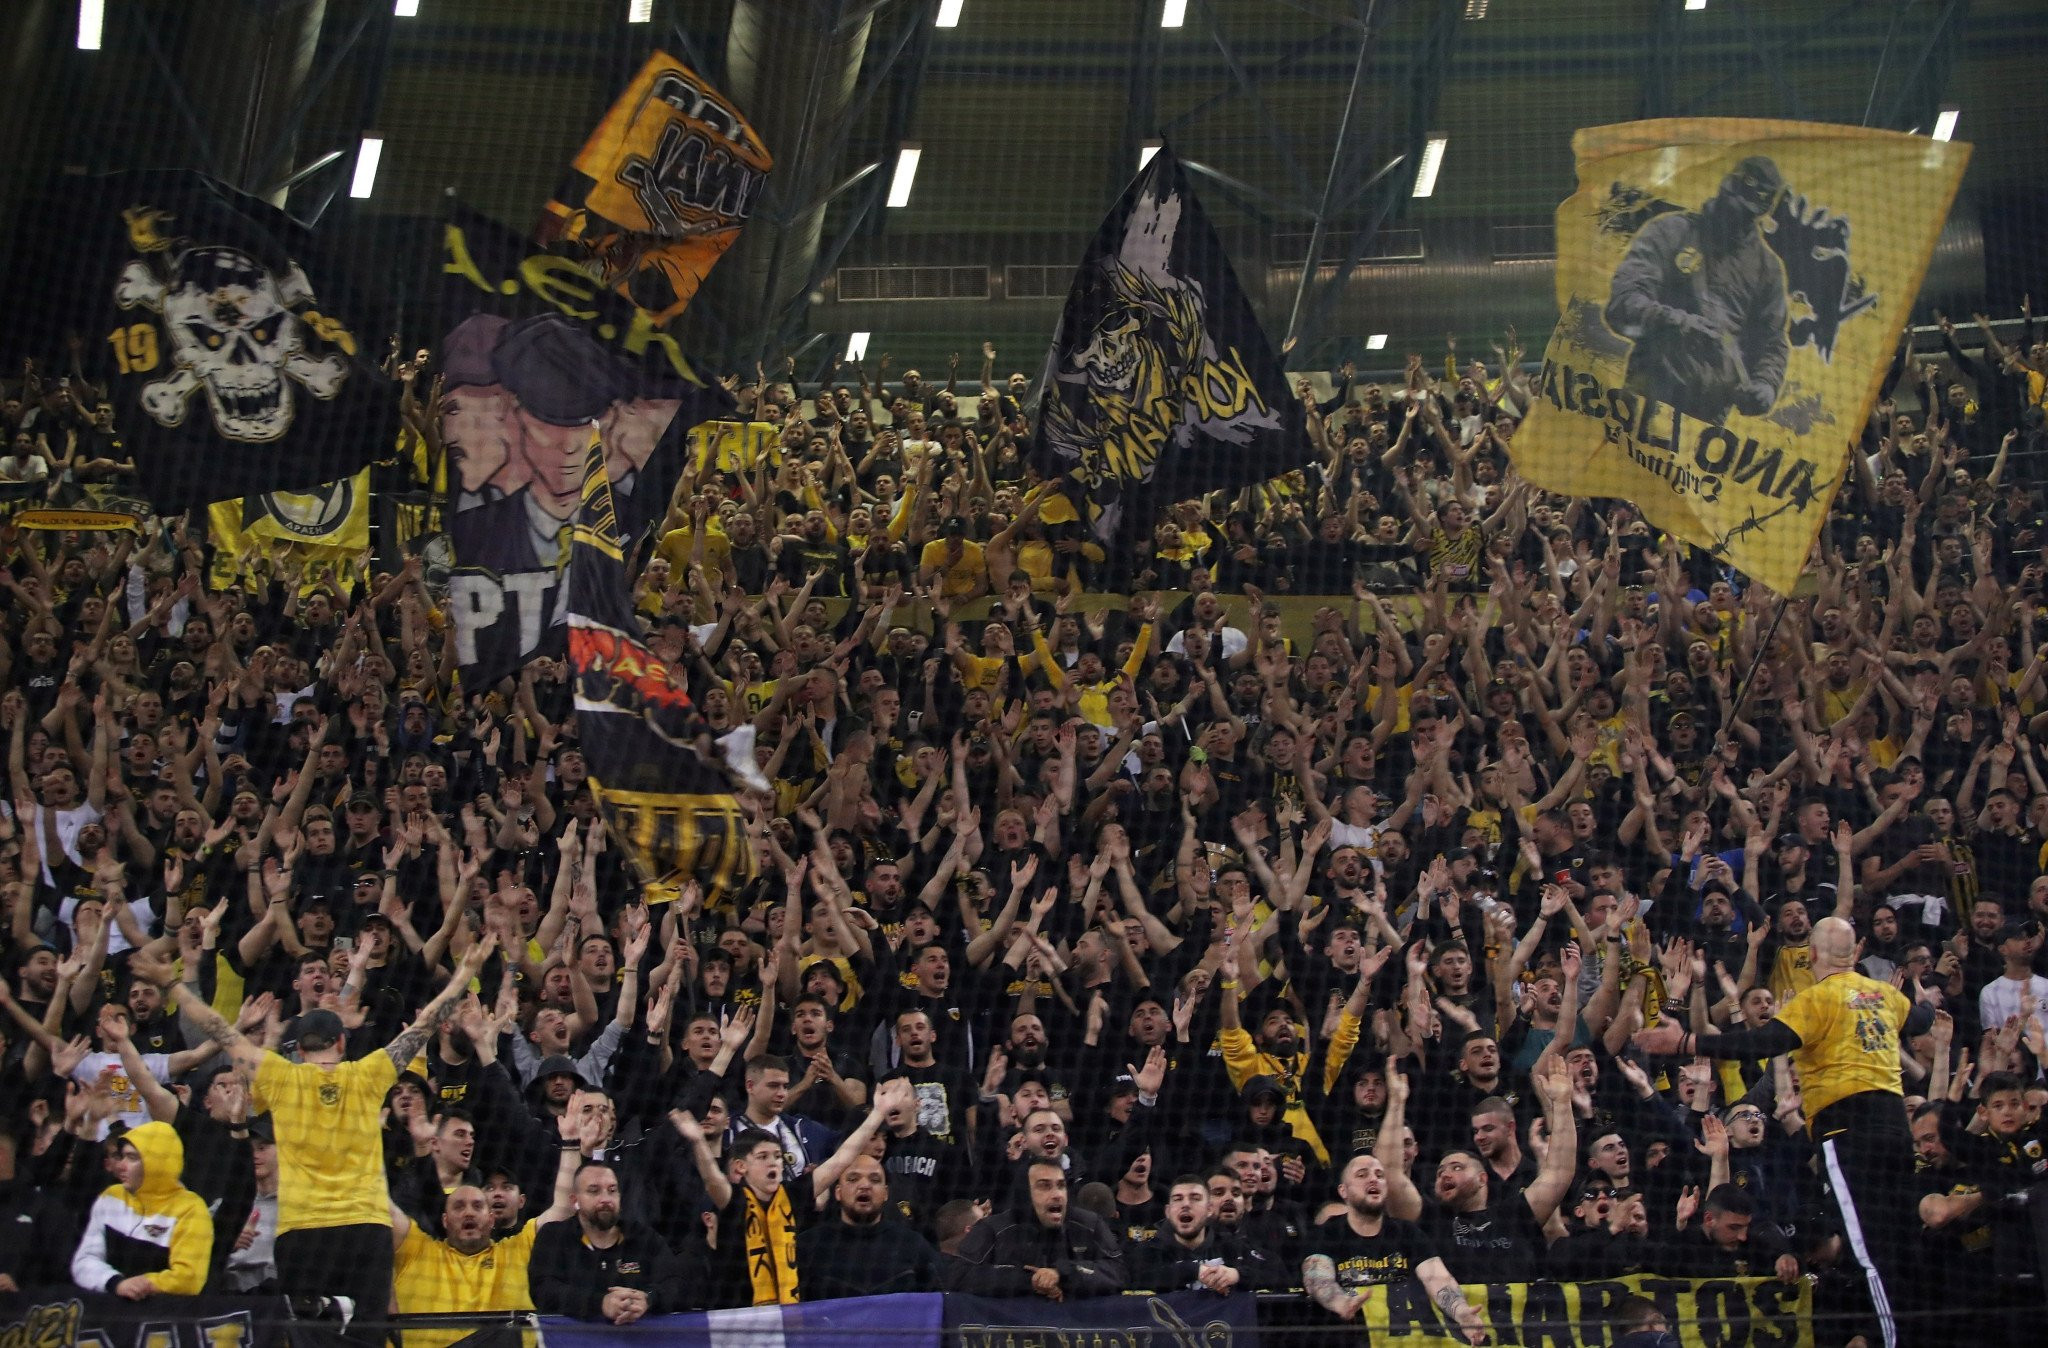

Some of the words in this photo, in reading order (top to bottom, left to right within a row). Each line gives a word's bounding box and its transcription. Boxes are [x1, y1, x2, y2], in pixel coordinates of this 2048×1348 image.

[107, 322, 160, 376] 19
[285, 521, 323, 535] ΔΡΑΣΗ
[1337, 1256, 1389, 1272] original
[1387, 1279, 1801, 1348] AIARTOS
